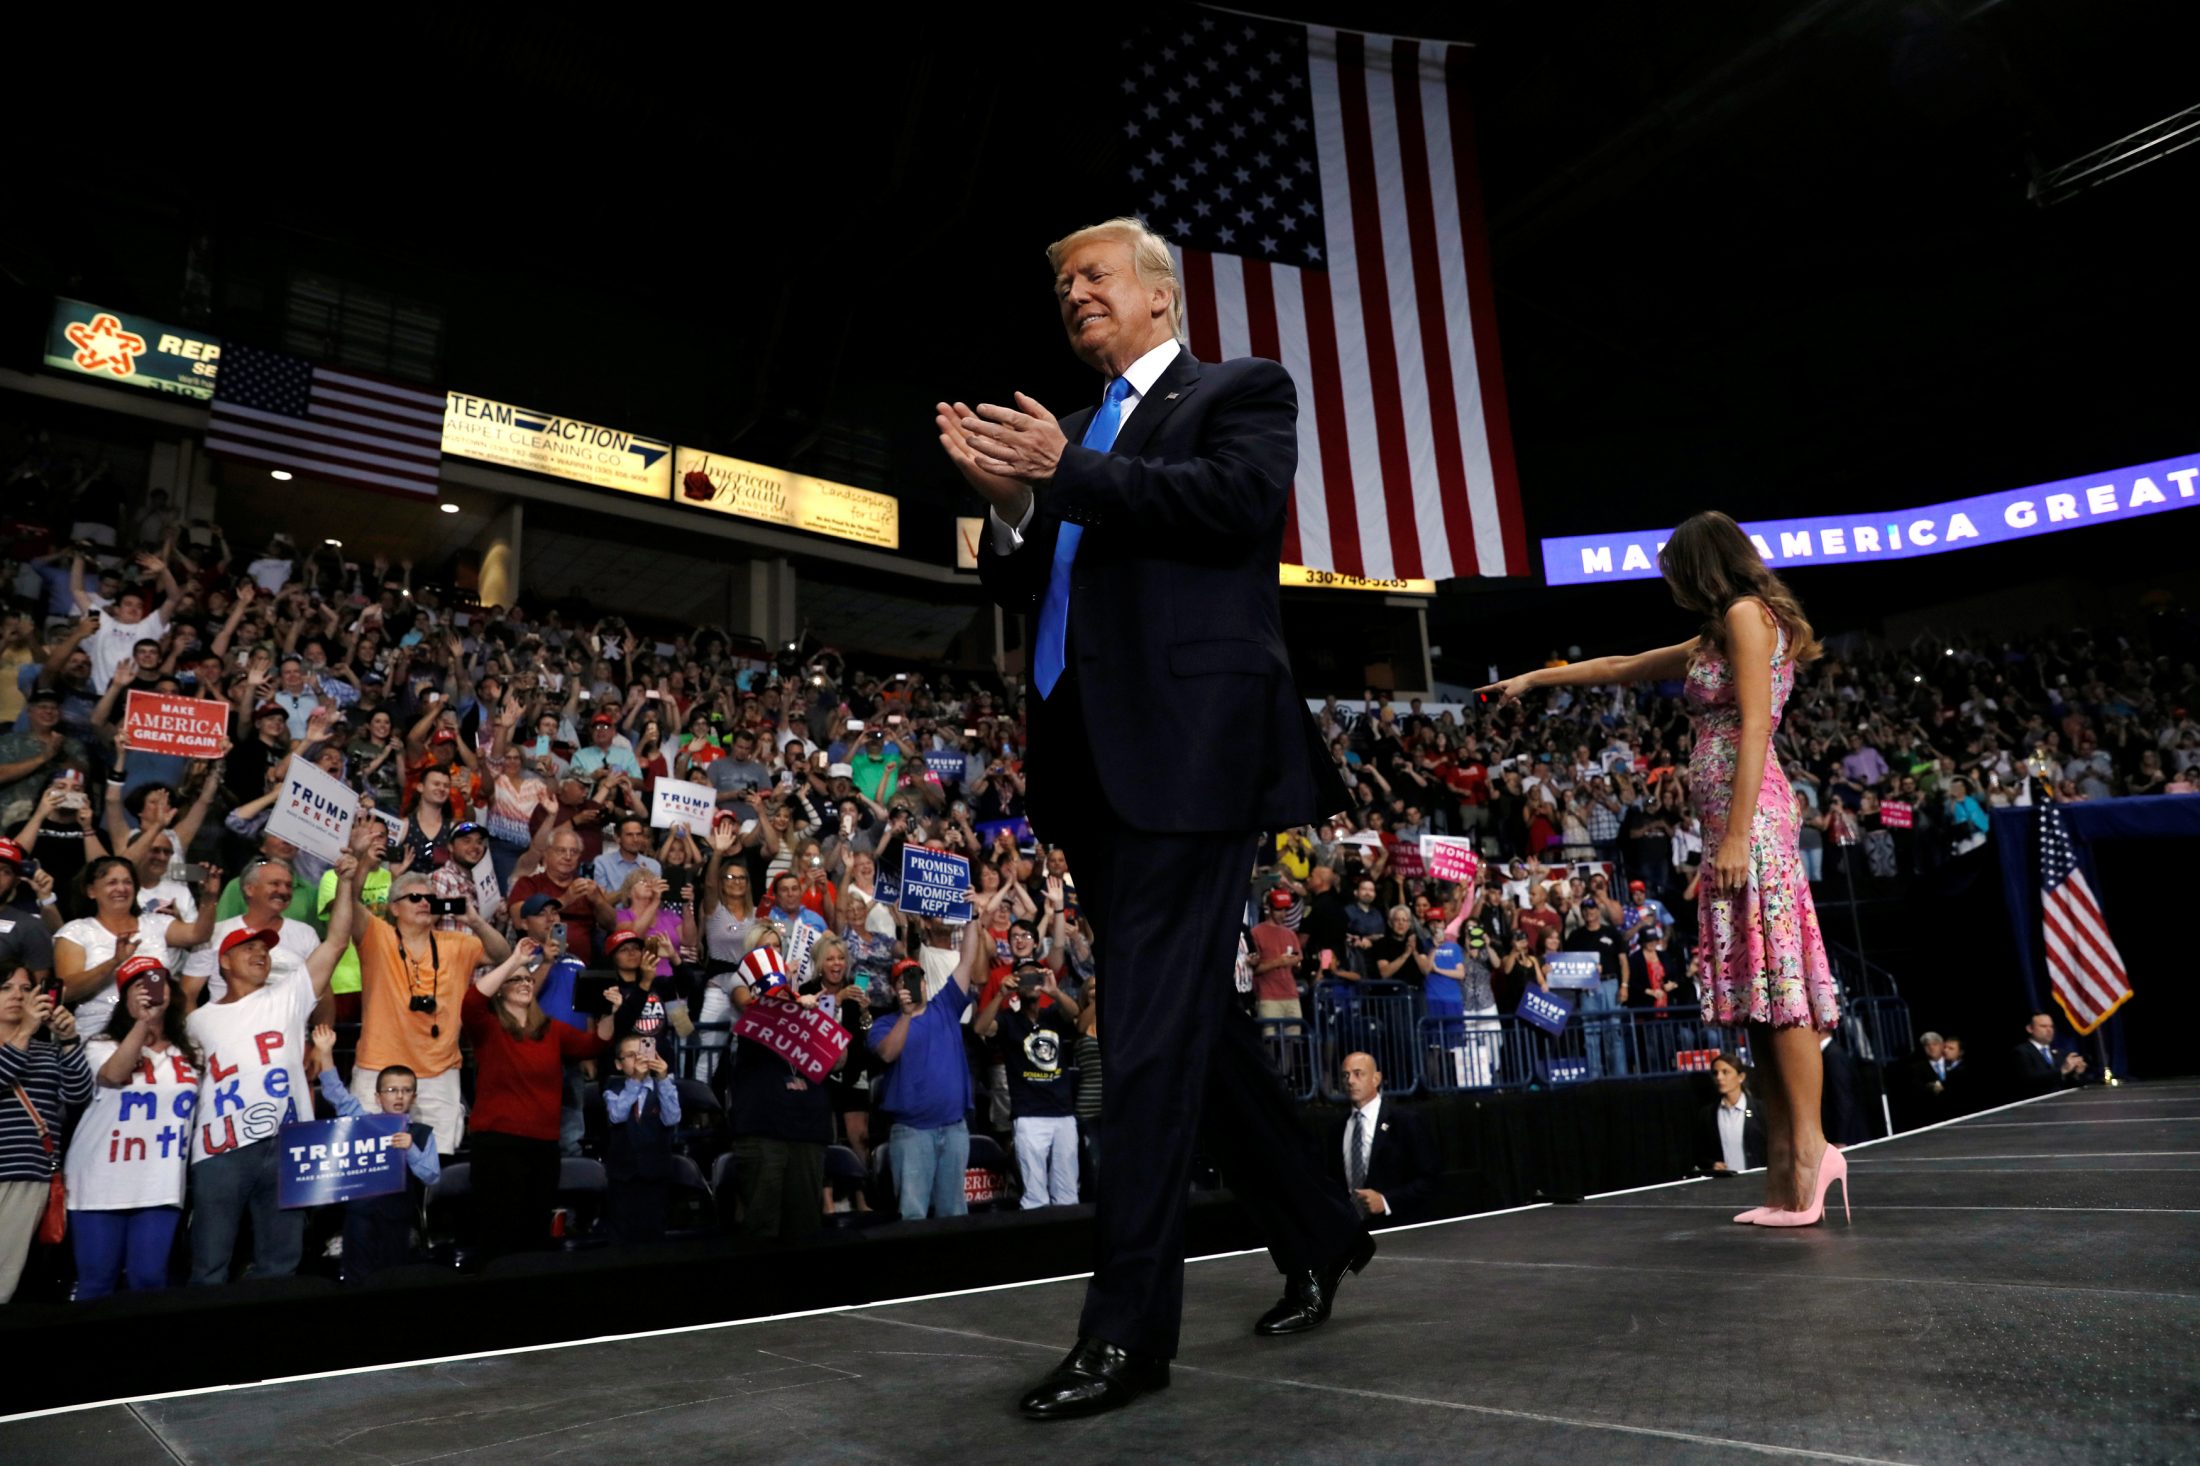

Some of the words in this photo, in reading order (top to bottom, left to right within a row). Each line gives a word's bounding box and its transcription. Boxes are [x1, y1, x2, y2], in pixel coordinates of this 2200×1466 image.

[450, 393, 513, 426] TEAM
[546, 418, 629, 452] ACTION
[509, 431, 593, 461] CLEANING
[686, 455, 782, 493] American
[716, 478, 787, 511] Beauty
[1581, 542, 1667, 574] MA
[1750, 512, 1980, 560] AMERICA
[2003, 467, 2199, 529] GREAT
[161, 703, 196, 716] MAKE
[128, 711, 223, 736] AMERICA
[133, 728, 175, 743] GREAT
[176, 734, 217, 748] AGAIN
[927, 757, 964, 766] TRUMP
[291, 780, 349, 822] TRUMP
[661, 792, 710, 809] TRUMP
[665, 802, 705, 816] PENCE
[290, 799, 342, 833] PENCE
[1435, 843, 1480, 865] WOMEN
[1447, 858, 1466, 870] FOR
[910, 856, 965, 877] PROMISES
[922, 870, 956, 887] MADE
[908, 883, 965, 904] PROMISES
[921, 898, 950, 914] KEPT
[797, 930, 815, 983] TRUMP
[1550, 961, 1596, 970] TRUMP
[1526, 991, 1567, 1016] TRUMP
[759, 996, 850, 1051] WOMEN
[777, 1017, 811, 1043] FOR
[744, 1019, 823, 1073] TRUMP
[288, 1135, 393, 1162] TRUMP
[299, 1153, 387, 1174] PENCE
[316, 1171, 346, 1180] AMERICA
[346, 1168, 367, 1176] GREAT
